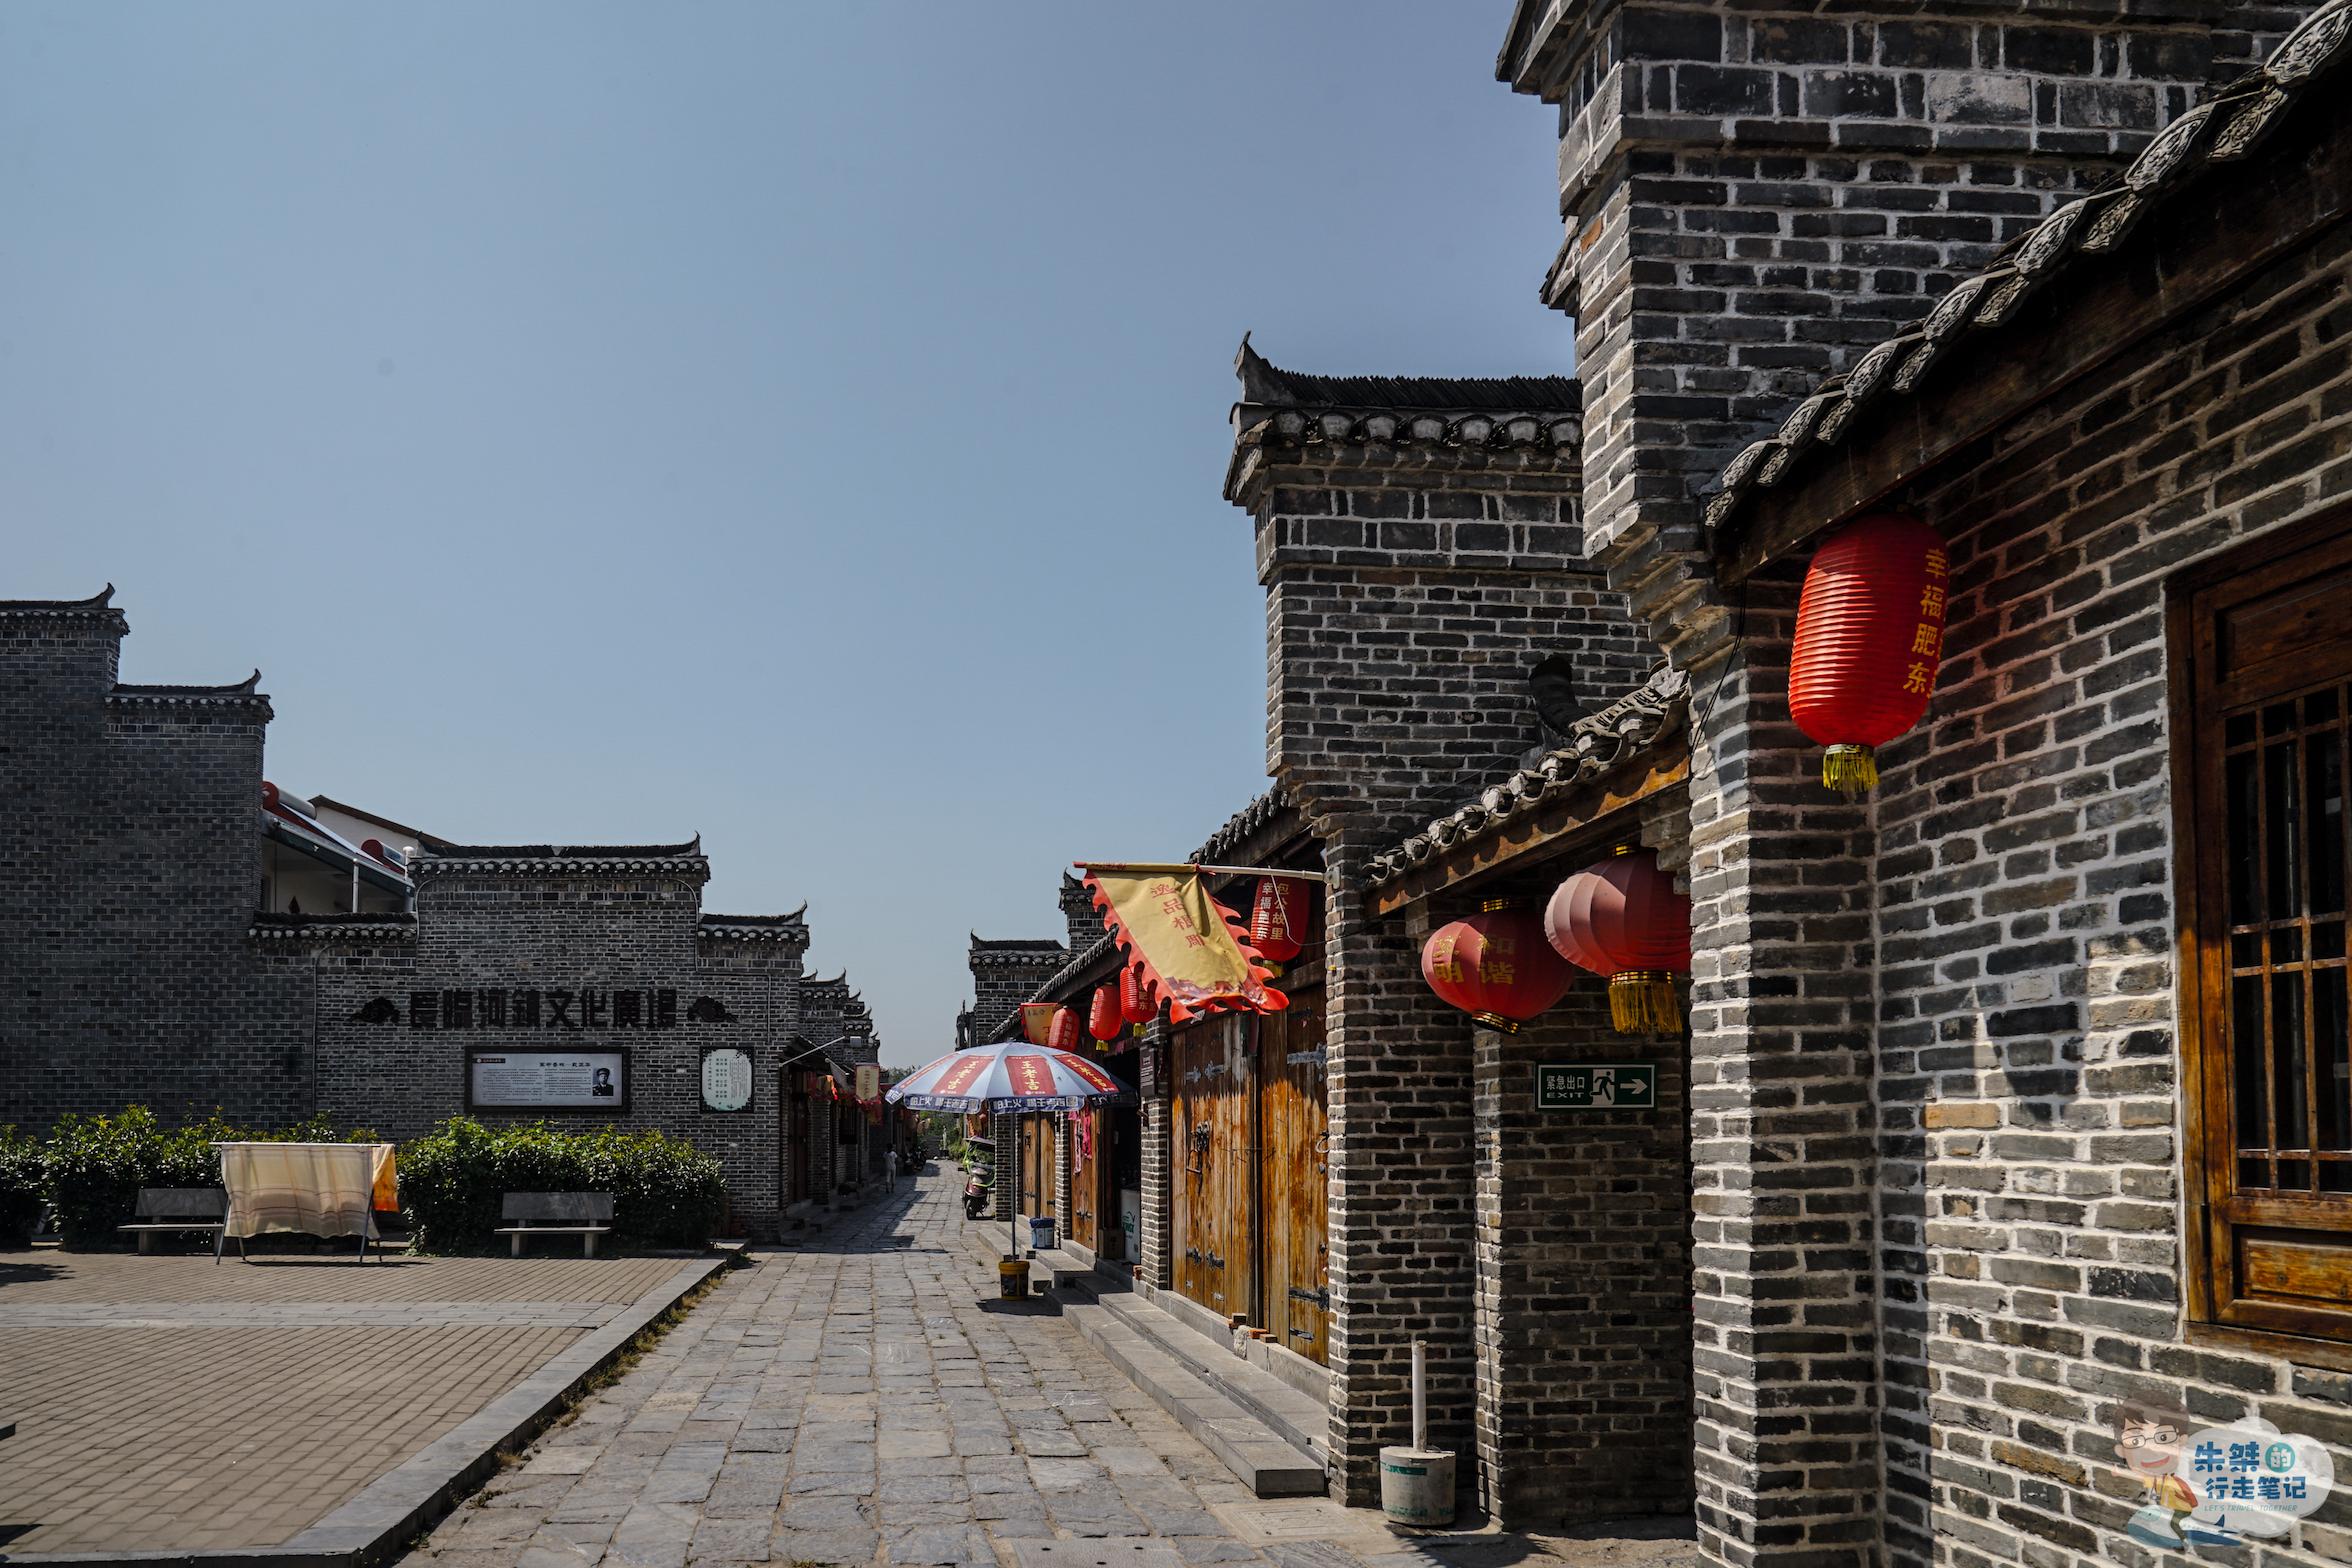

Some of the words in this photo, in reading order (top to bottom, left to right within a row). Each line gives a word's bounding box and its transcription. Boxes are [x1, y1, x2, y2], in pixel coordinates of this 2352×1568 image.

[1903, 547, 1947, 694] 幸福肥东
[1256, 882, 1274, 940] 幸福肥东
[1270, 882, 1289, 940] 包公故里
[1478, 935, 1516, 984] 和谐
[947, 1060, 980, 1090] 王老吉
[1021, 1060, 1041, 1091] 王老吉
[1546, 1074, 1586, 1090] 紧急出口
[1546, 1091, 1585, 1099] EXIT
